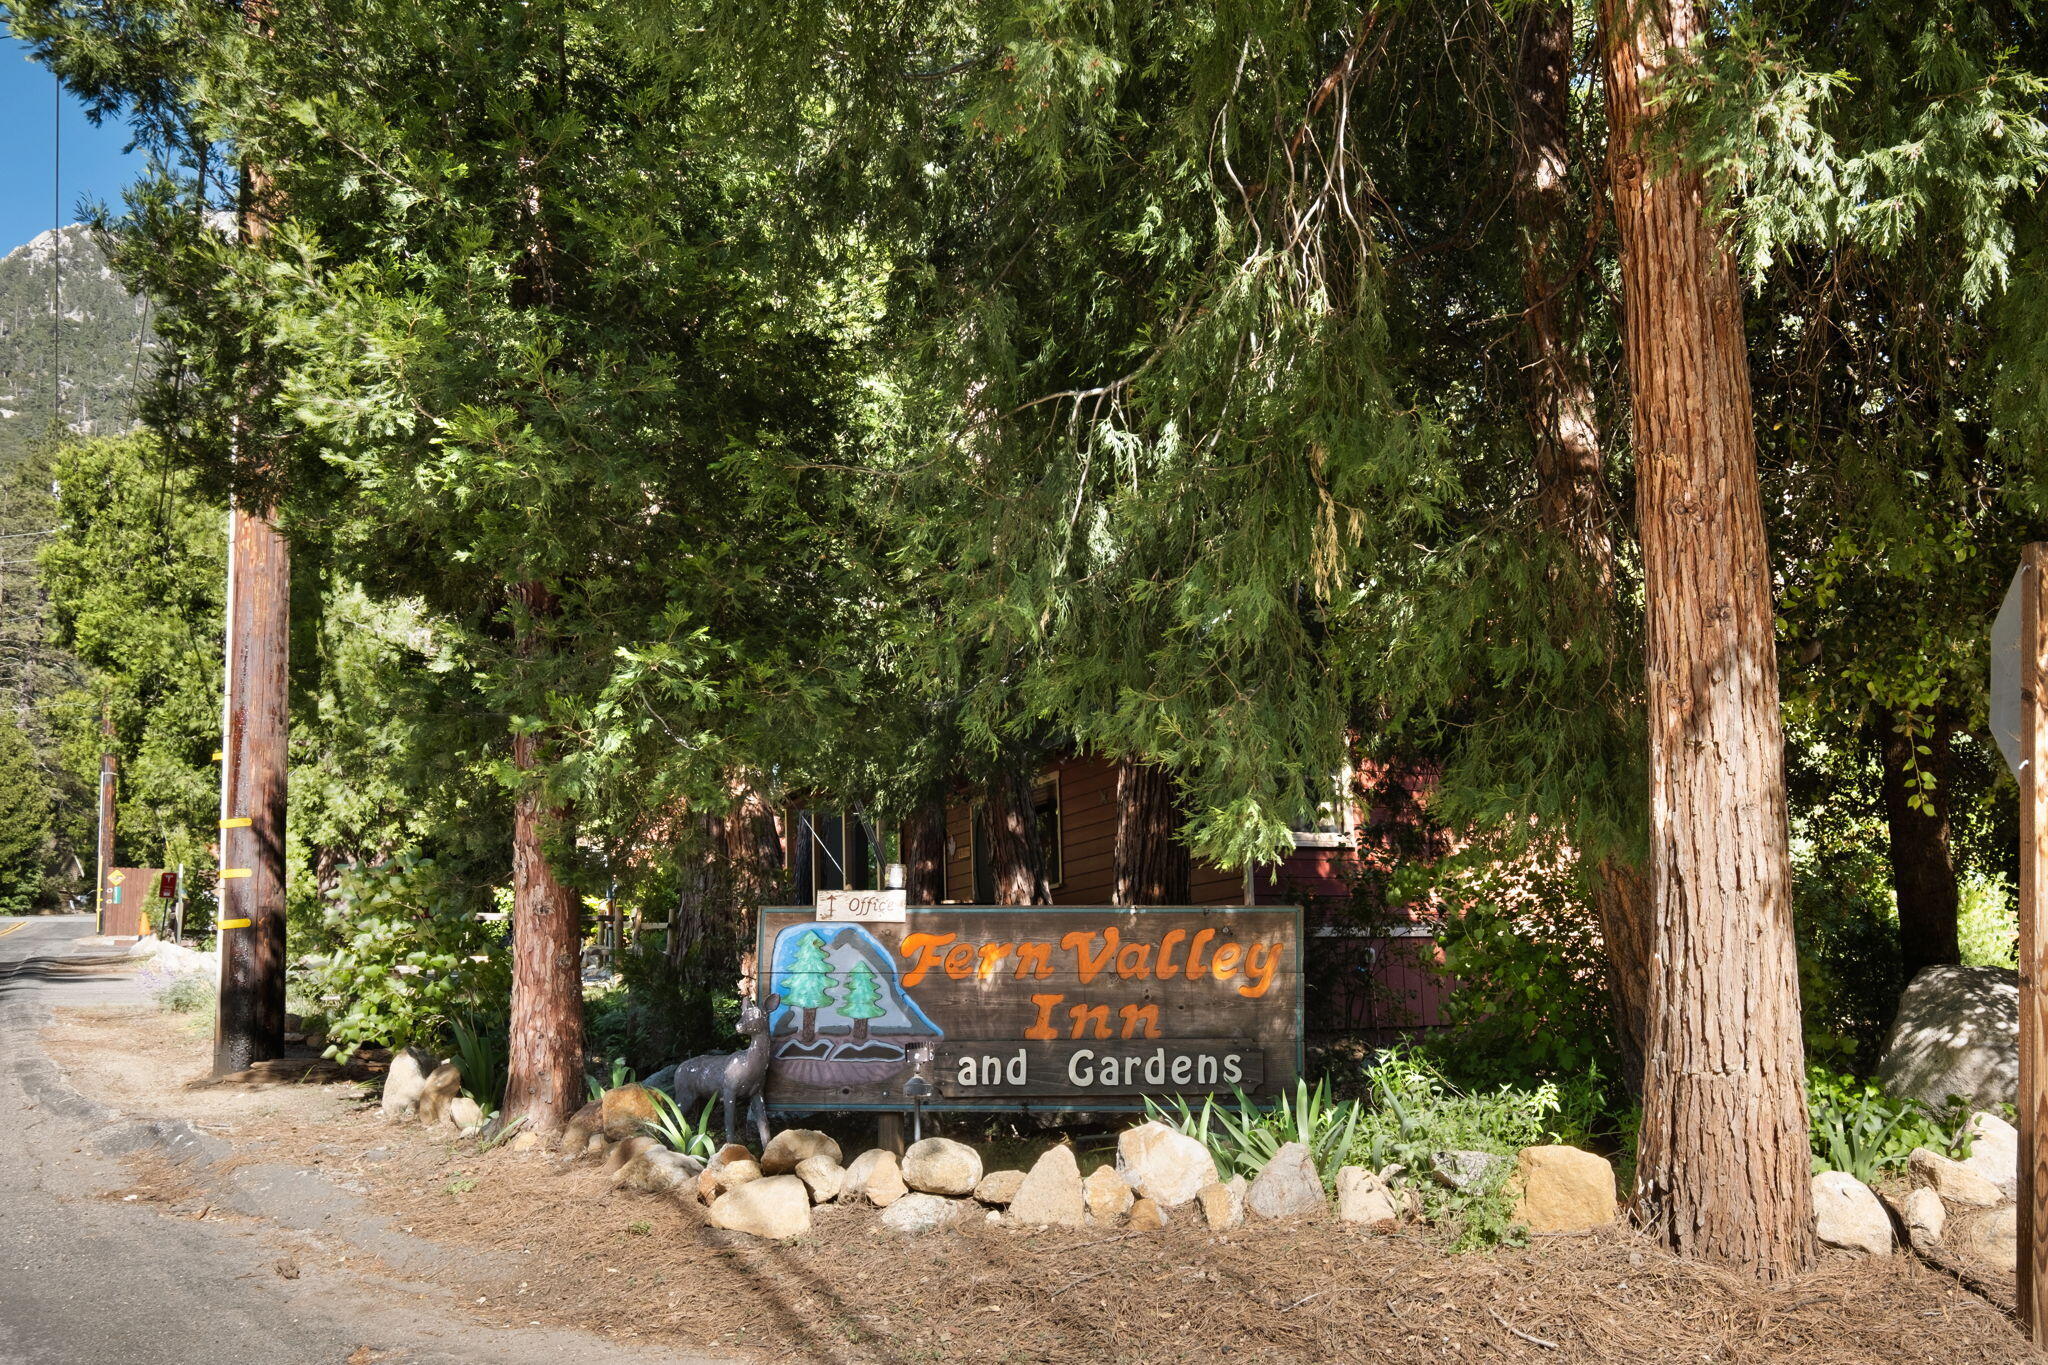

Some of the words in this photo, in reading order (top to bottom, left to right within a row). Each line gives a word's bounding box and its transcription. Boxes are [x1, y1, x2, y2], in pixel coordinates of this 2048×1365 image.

[848, 897, 894, 916] Office
[901, 931, 1054, 987] Fern
[1062, 928, 1282, 998] Valley
[1025, 994, 1162, 1041] Inn
[957, 1048, 1027, 1086] and
[1068, 1048, 1242, 1087] Gardens
